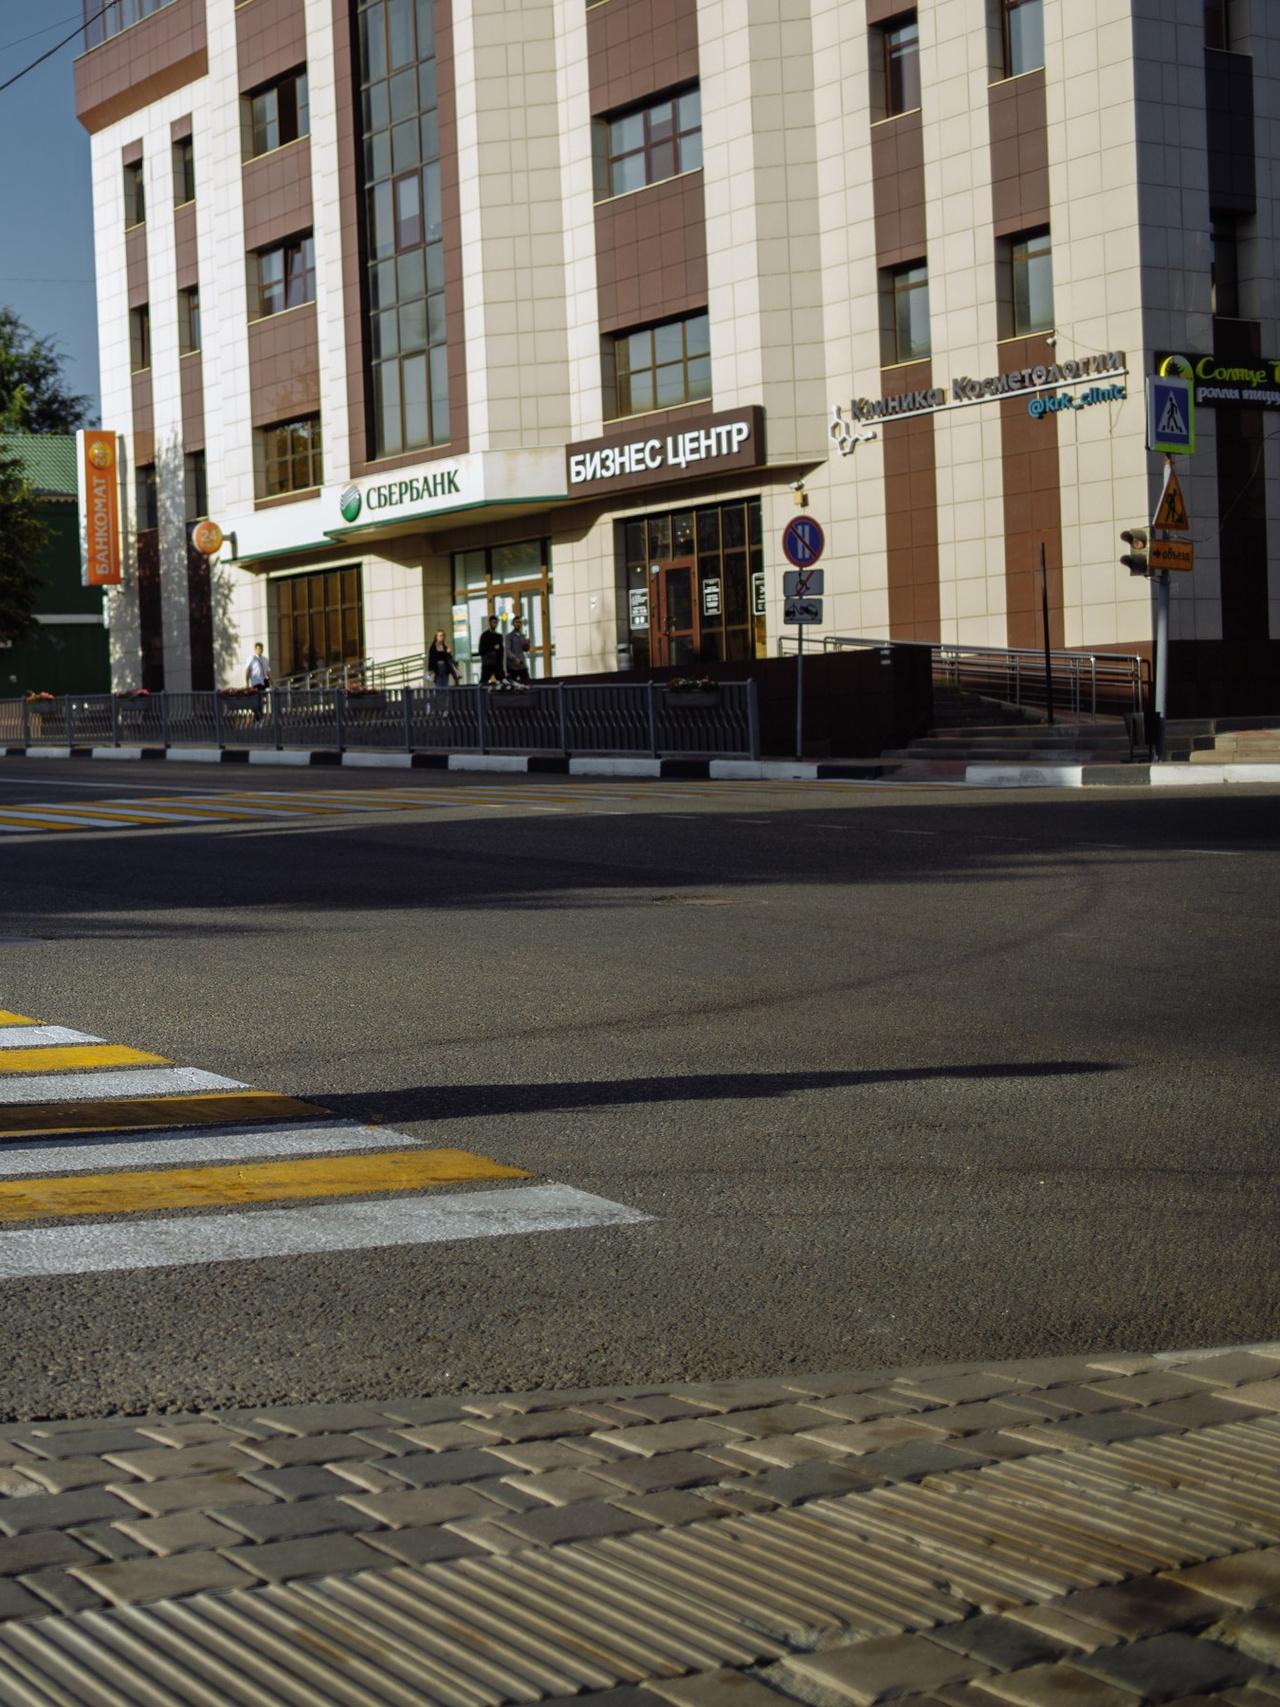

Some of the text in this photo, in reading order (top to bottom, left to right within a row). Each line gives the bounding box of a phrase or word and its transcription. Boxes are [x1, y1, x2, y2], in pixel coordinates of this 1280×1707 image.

[851, 350, 1126, 422] Клиника Косметологии
[1195, 356, 1268, 387] Солнце
[1028, 384, 1127, 419] @krk_clinic
[570, 422, 751, 484] БИЗНЕС ЦЕНТР
[366, 469, 460, 510] СБЕРБАНК
[92, 476, 109, 575] БАНКОМАТ
